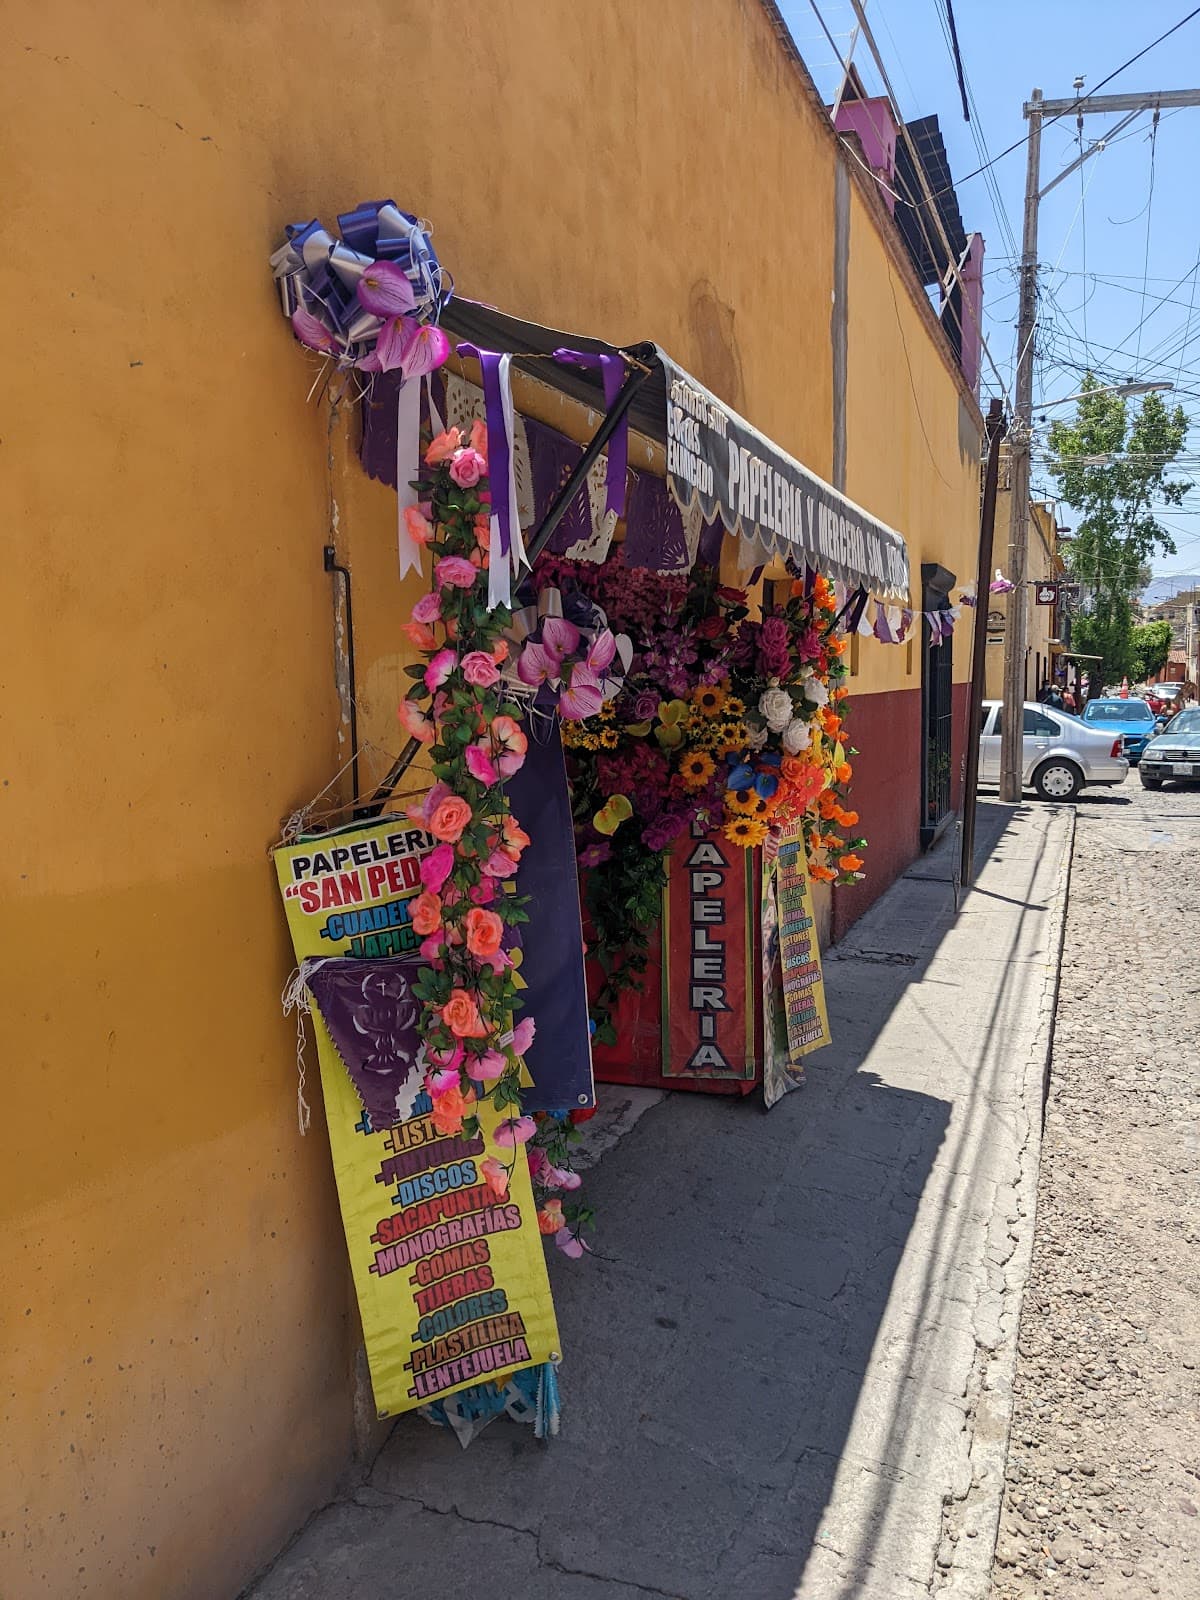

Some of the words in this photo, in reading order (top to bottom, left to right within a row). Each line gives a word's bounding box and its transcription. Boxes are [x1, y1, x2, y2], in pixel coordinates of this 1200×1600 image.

[667, 436, 714, 497] ENMICADO
[728, 438, 803, 546] PAPELERIA
[806, 496, 815, 552] Y
[292, 828, 442, 880] PAPELERI
[367, 851, 427, 898] PED
[320, 896, 413, 941] -CUADER
[344, 926, 425, 958] -LAPIC
[384, 1117, 462, 1154] -LIST
[391, 1160, 477, 1209] -DISCOS
[369, 1204, 522, 1278] -MONOGRAFÍAS
[409, 1239, 490, 1287] -GOMAS
[411, 1289, 509, 1342] -COLORES
[413, 1264, 495, 1317] TIJERAS
[403, 1311, 527, 1372] -PLASTILINA
[407, 1337, 531, 1400] -LENTEJUELA
